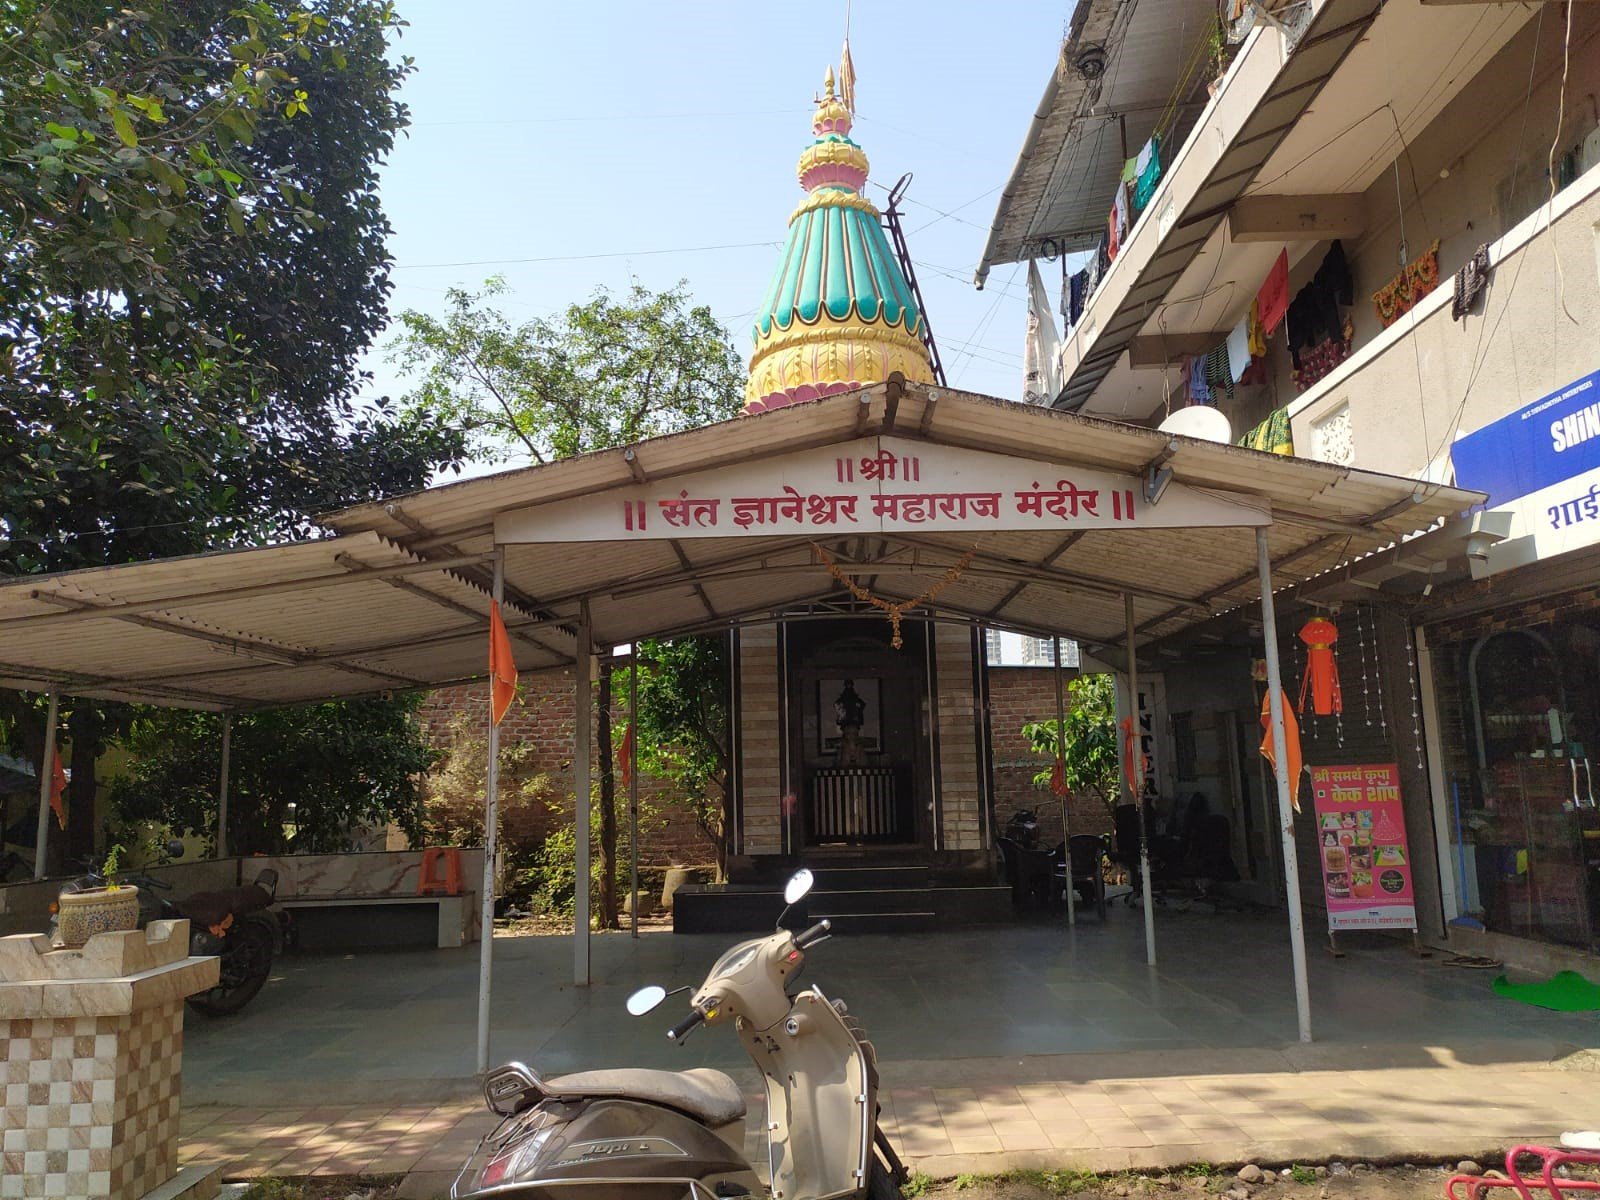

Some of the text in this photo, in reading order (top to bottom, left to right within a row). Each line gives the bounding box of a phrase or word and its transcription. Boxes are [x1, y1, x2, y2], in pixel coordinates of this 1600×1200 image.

[1550, 402, 1600, 452] SHiN
[658, 489, 720, 527] संत
[731, 485, 858, 530] ज्ञानेश्वर
[870, 492, 1002, 524] महाराज
[1014, 480, 1099, 521] मंदीर
[1313, 767, 1391, 785] श्री समर्थ कृपा
[1331, 781, 1399, 803] केक शॉप
